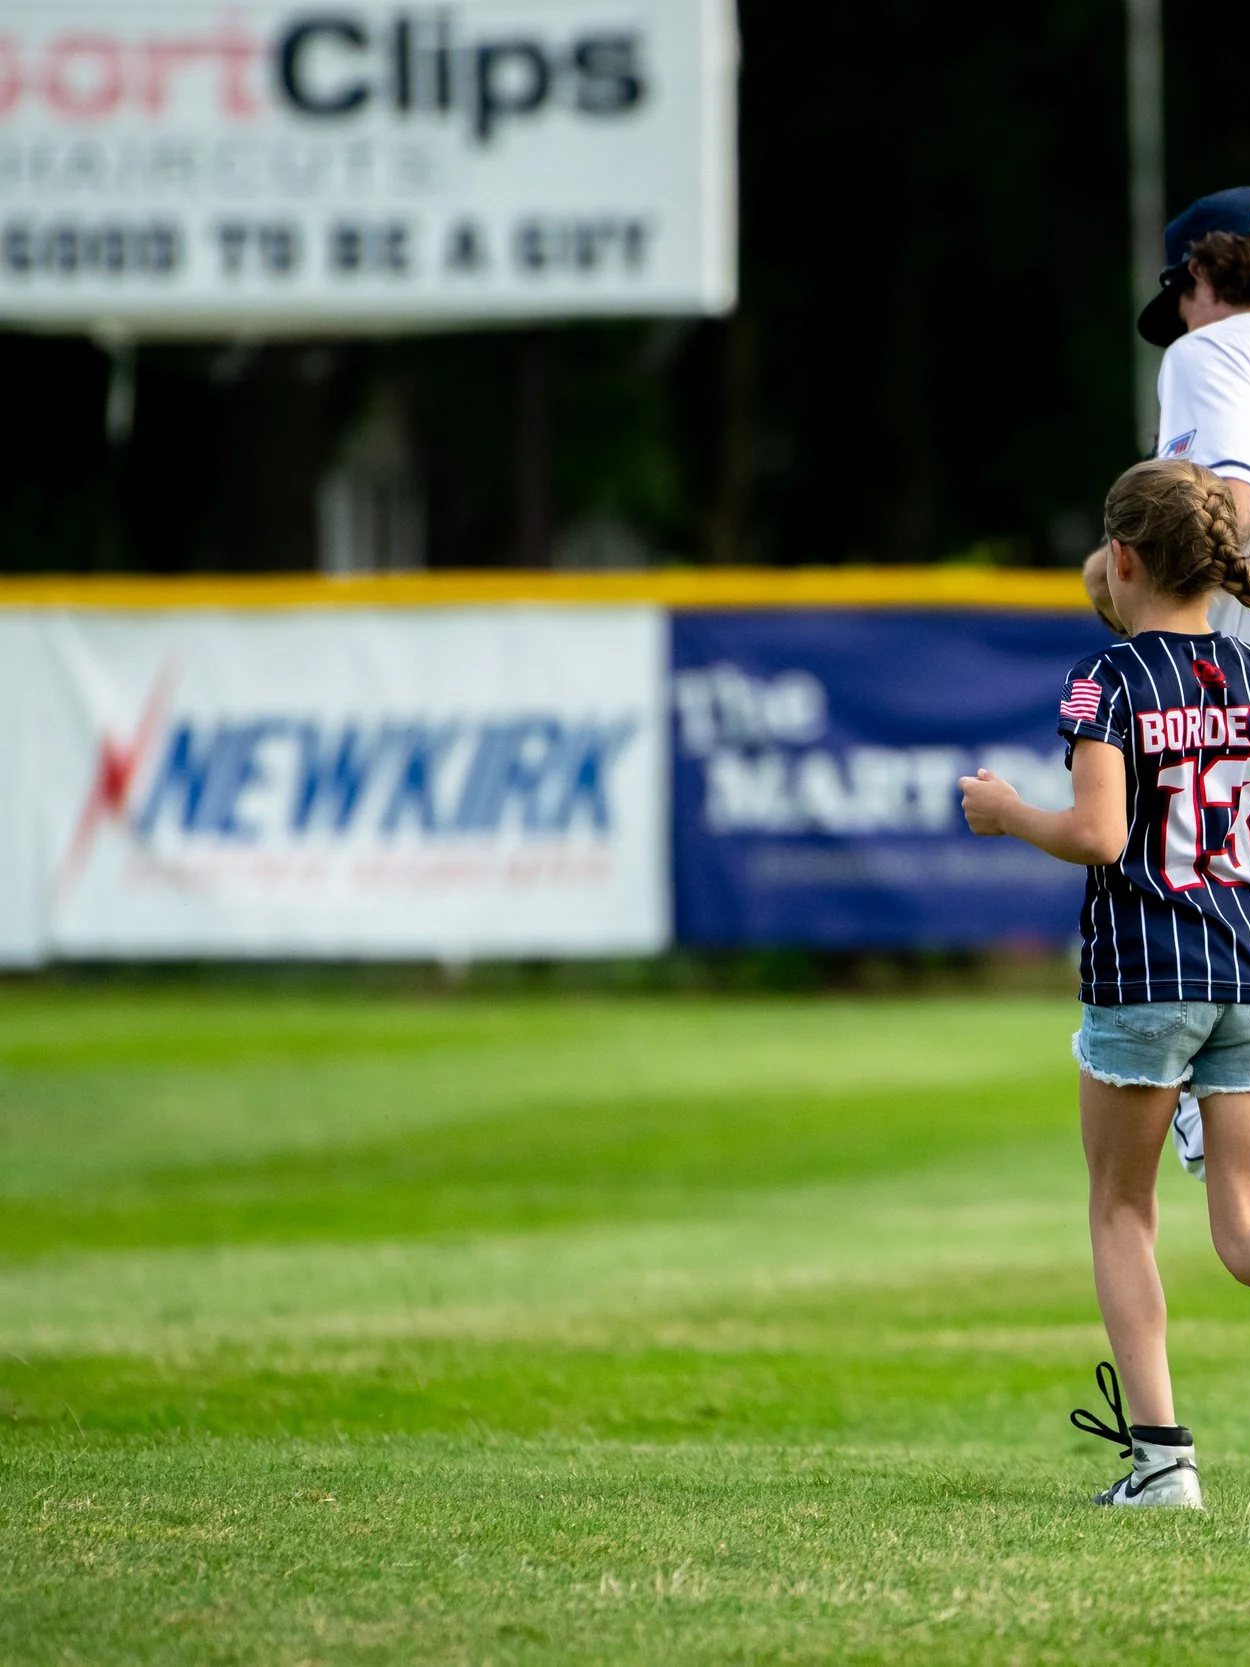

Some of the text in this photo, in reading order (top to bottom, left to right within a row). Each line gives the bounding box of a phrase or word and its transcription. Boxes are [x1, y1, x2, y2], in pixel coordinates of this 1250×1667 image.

[3, 216, 183, 279] GOOD
[212, 216, 299, 279] TO
[328, 216, 412, 279] BE
[442, 216, 490, 279] A
[132, 711, 637, 840] NEWKIRK
